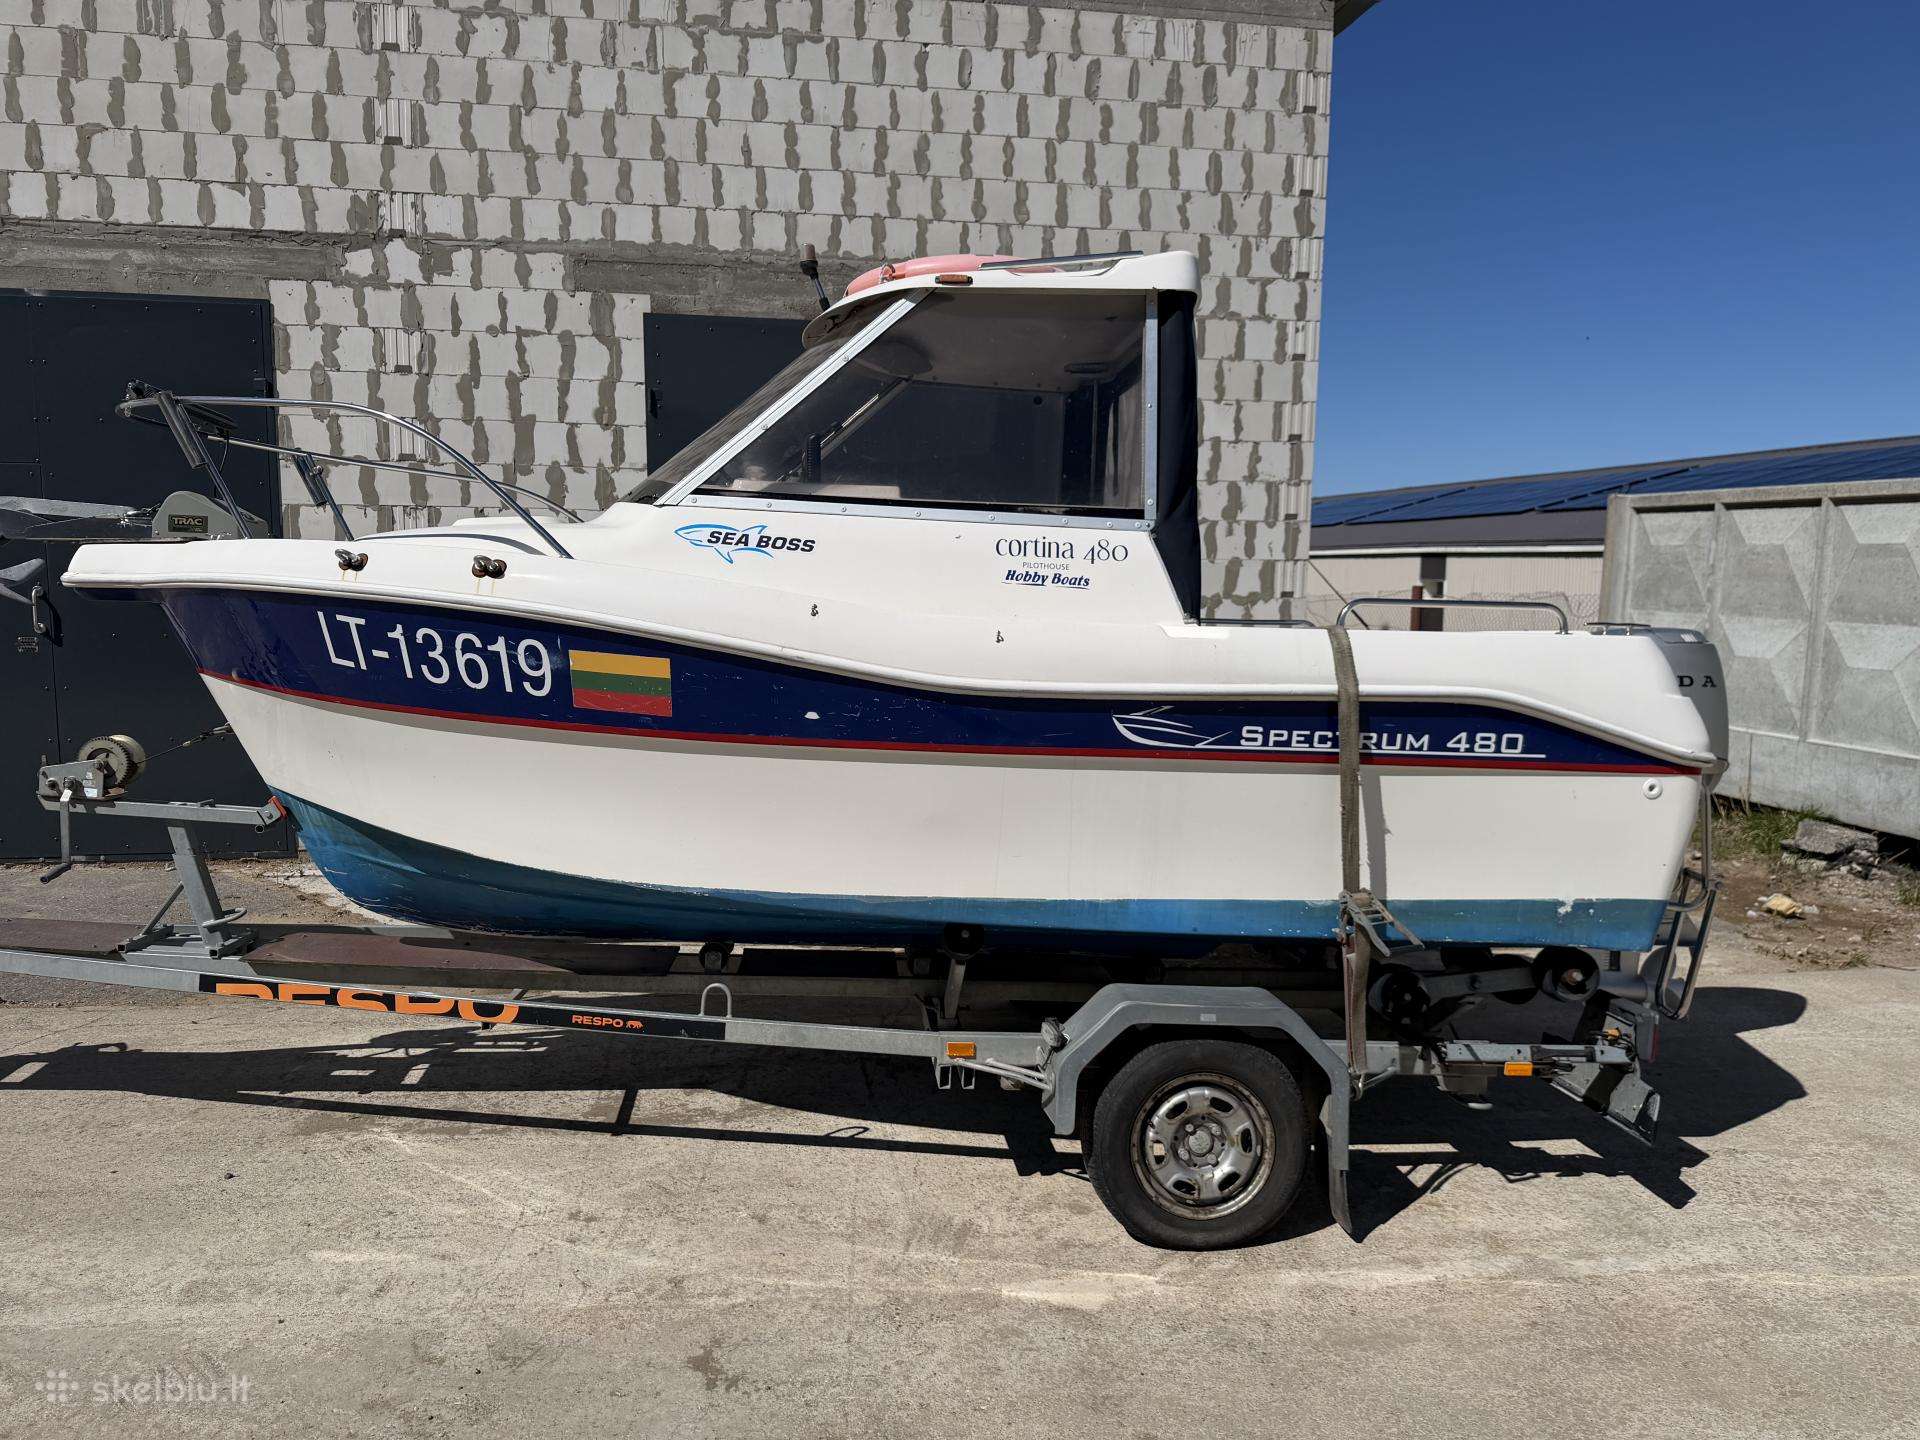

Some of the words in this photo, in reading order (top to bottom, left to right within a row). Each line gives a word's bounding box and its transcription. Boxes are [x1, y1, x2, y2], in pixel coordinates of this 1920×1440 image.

[172, 517, 203, 526] TRAC
[707, 530, 750, 547] SEA
[756, 535, 816, 553] BOSS
[995, 536, 1074, 559] cortina
[1083, 539, 1128, 565] 480
[1022, 561, 1071, 571] PILOTHOUSE
[1005, 569, 1048, 585] Hobby
[1051, 573, 1090, 588] Boats
[317, 610, 552, 697] LT-13619
[1240, 725, 1430, 751] SPECRUM
[1446, 731, 1524, 753] 480
[571, 1014, 624, 1028] RESPO
